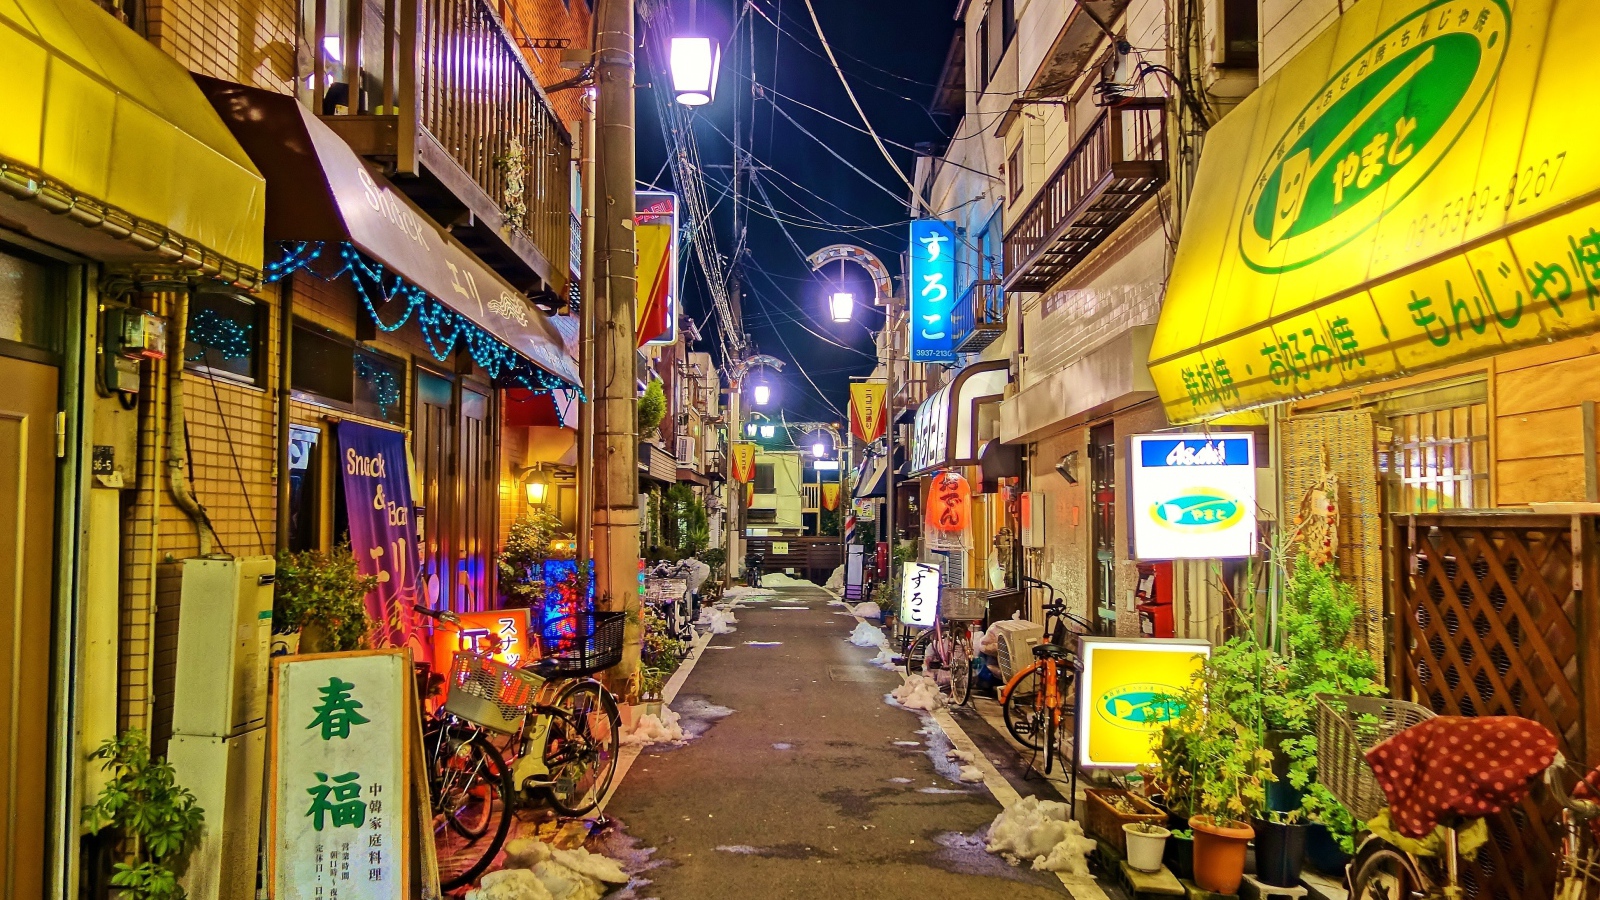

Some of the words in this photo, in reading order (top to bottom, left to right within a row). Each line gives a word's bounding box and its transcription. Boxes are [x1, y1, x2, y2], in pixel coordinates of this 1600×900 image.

[1332, 116, 1417, 205] やまと
[357, 167, 430, 252] Snack
[1405, 150, 1567, 251] 03-5399-8267
[445, 258, 484, 317] エリ
[919, 230, 949, 340] すろこ
[346, 447, 387, 479] Snack
[1165, 440, 1227, 467] Asahi
[373, 483, 387, 511] &
[387, 500, 408, 527] Bar
[939, 478, 963, 526] おでん
[1190, 508, 1228, 522] やまと
[911, 569, 926, 622] すろこ
[499, 618, 520, 671] スナッ
[303, 676, 371, 832] 春福
[369, 782, 382, 882] 中韓家庭料理
